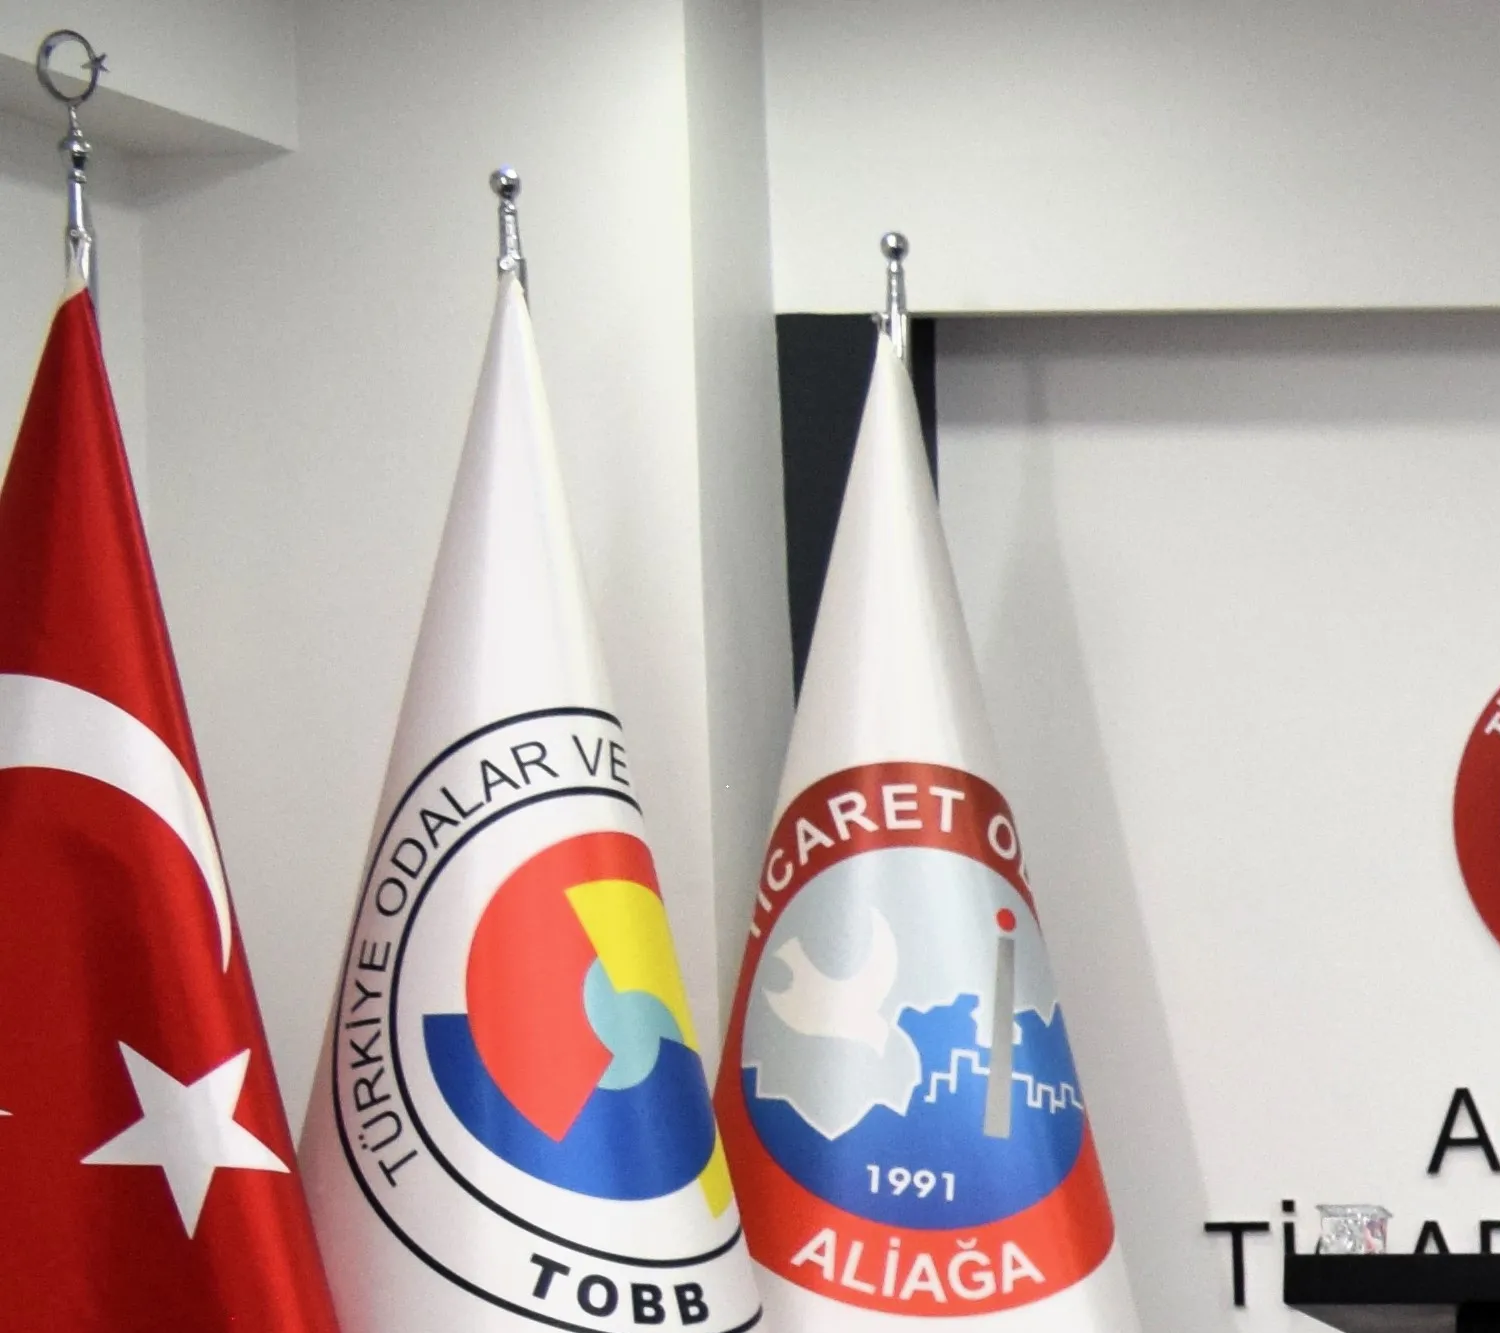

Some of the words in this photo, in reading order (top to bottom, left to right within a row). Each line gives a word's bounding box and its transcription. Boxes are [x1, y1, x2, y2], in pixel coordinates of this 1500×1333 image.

[375, 740, 560, 917] ODALAR
[344, 939, 418, 1188] TÜRKİYE
[866, 1164, 956, 1201] 1991
[529, 1253, 710, 1326] TOBB
[791, 1226, 1045, 1304] ALİAĞA
